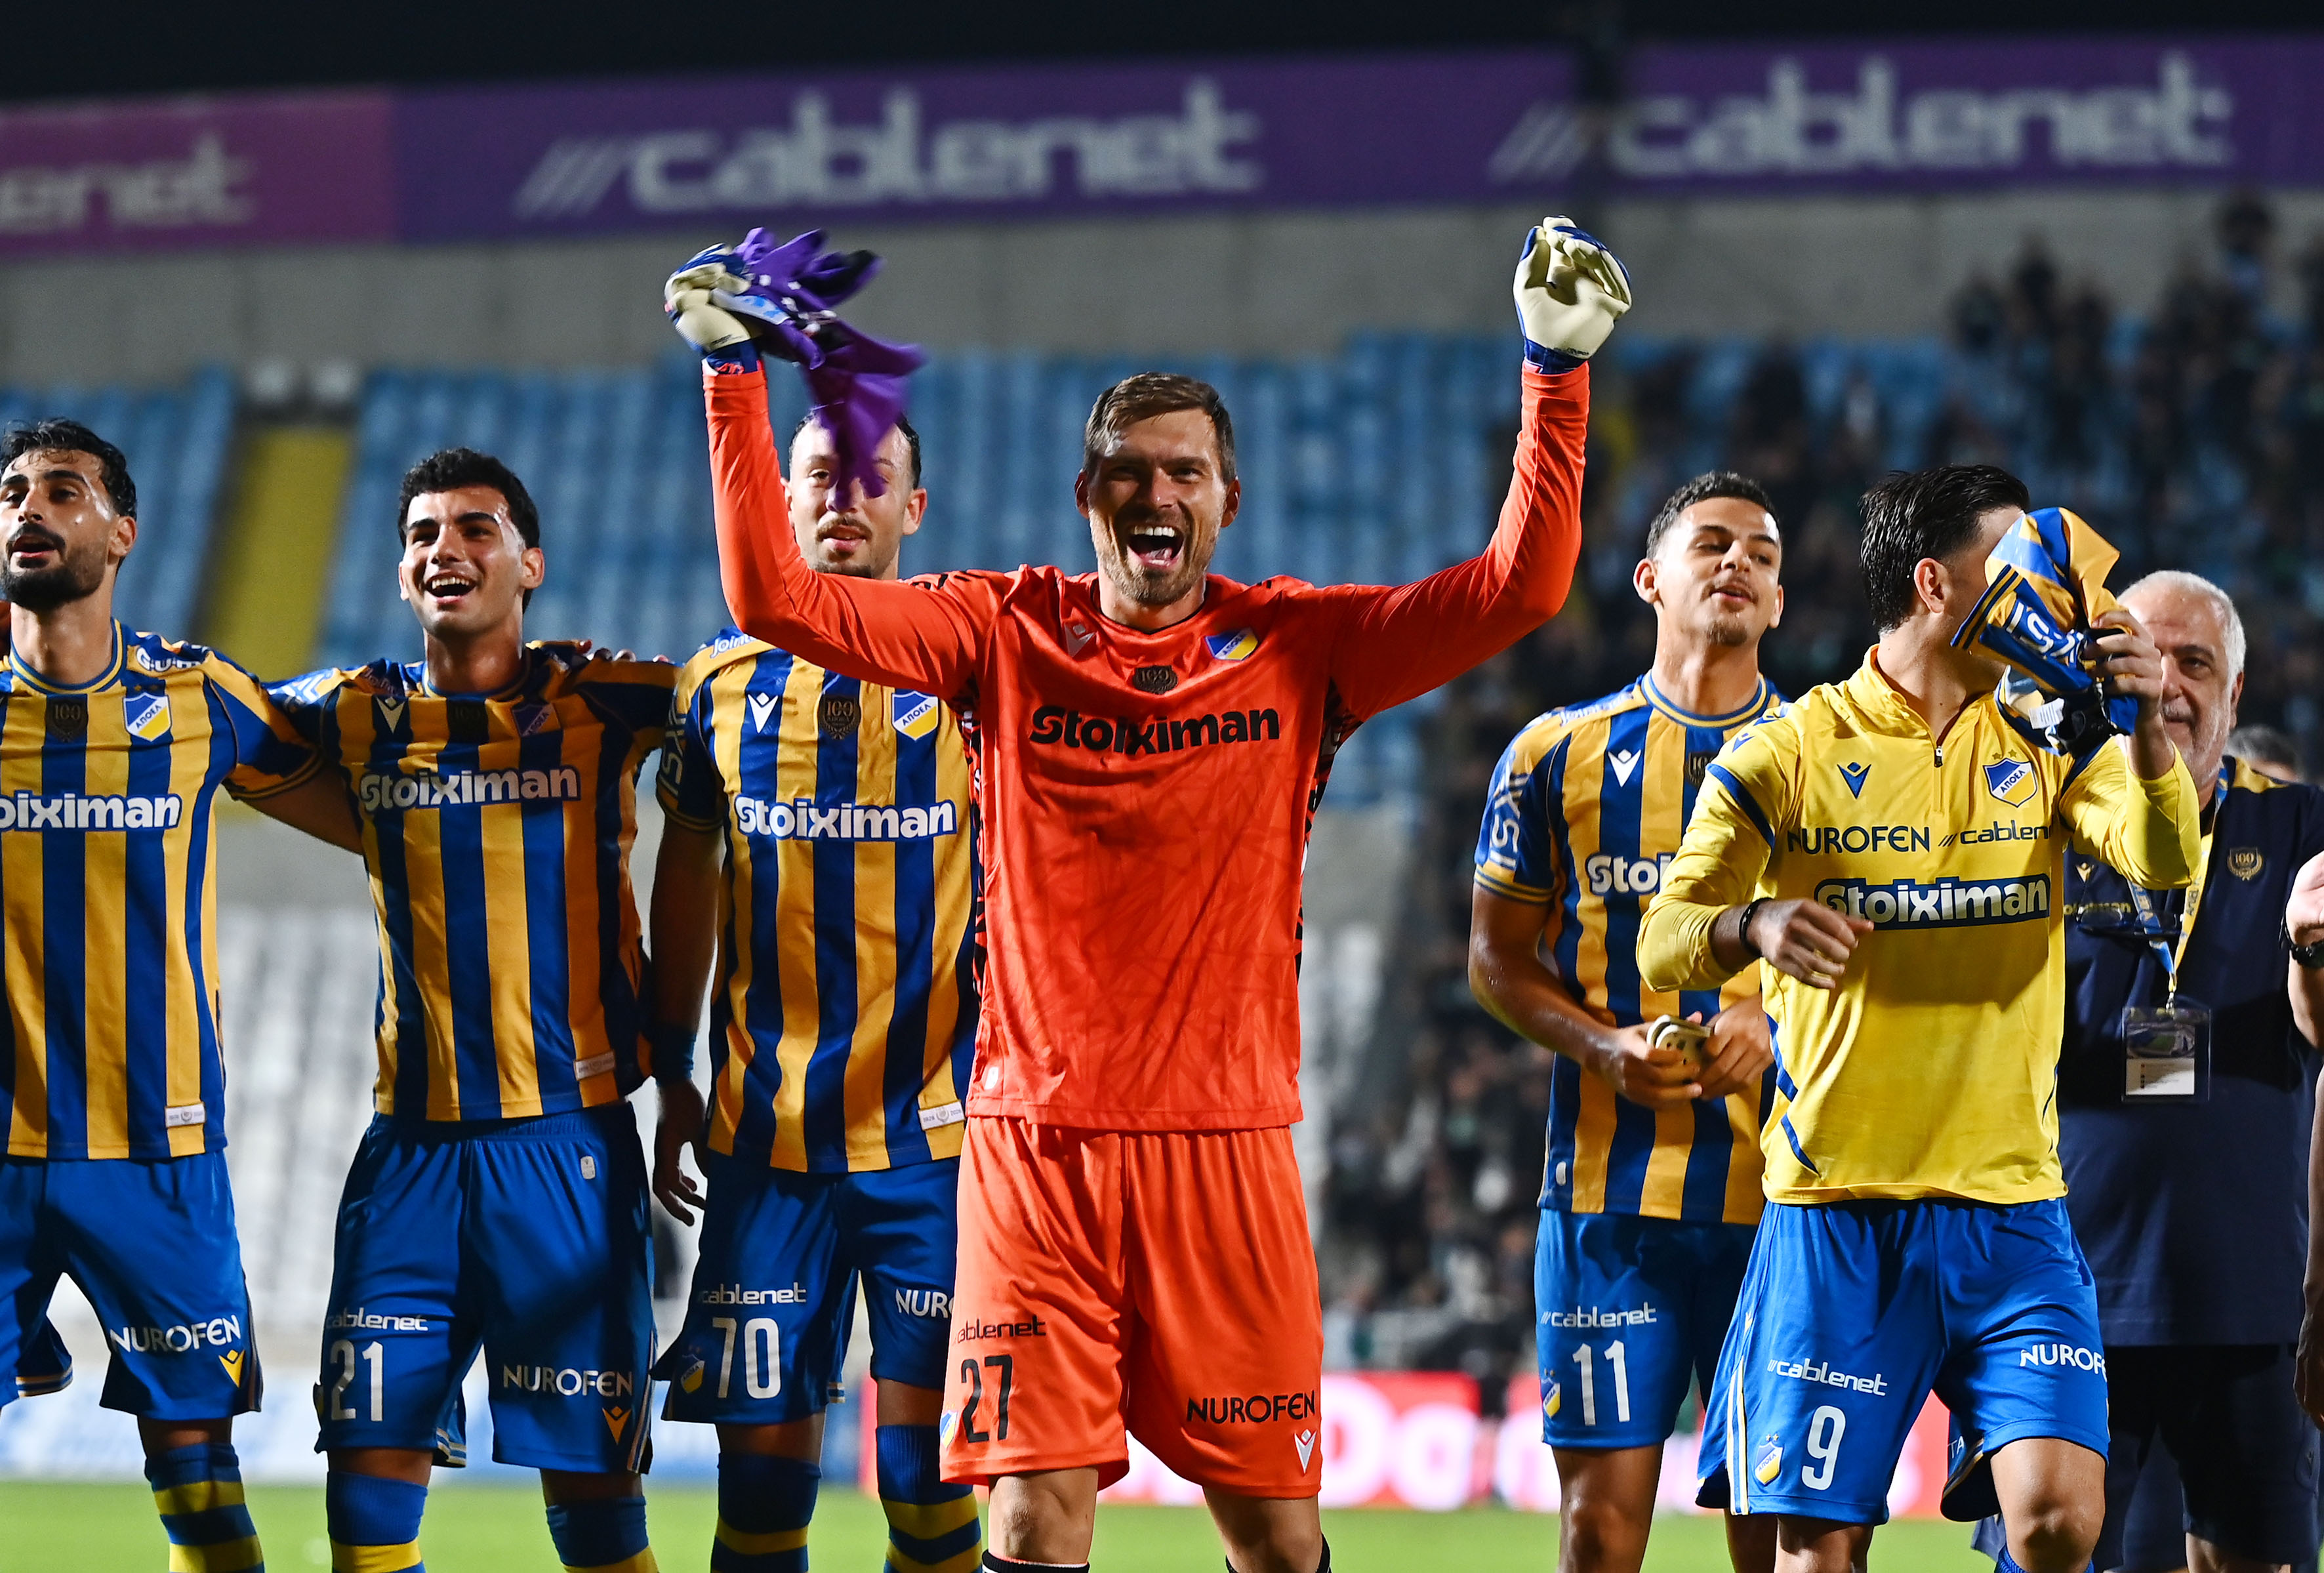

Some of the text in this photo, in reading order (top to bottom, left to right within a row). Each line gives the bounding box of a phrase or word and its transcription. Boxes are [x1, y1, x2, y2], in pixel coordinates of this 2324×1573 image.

[826, 701, 853, 716] 100
[1029, 705, 1280, 756] Stoiximan
[360, 767, 579, 810] Stoiximan
[0, 792, 181, 829] oiximan
[735, 797, 954, 838] Stoiximan
[1787, 820, 2050, 854] NUROFEN cablen
[1818, 879, 2048, 924] Stoiximan
[110, 1315, 241, 1353] NUROFEN
[954, 1314, 1047, 1343] ablenet
[1551, 1302, 1657, 1328] cablenet
[712, 1317, 782, 1399] 70
[1776, 1358, 1888, 1397] cablenet
[330, 1339, 384, 1421] 21
[503, 1364, 633, 1398] NUROFEN
[961, 1354, 1013, 1443] 27
[1572, 1339, 1631, 1427] 11
[1187, 1389, 1315, 1423] NUROFEN
[1801, 1405, 1846, 1491] 9
